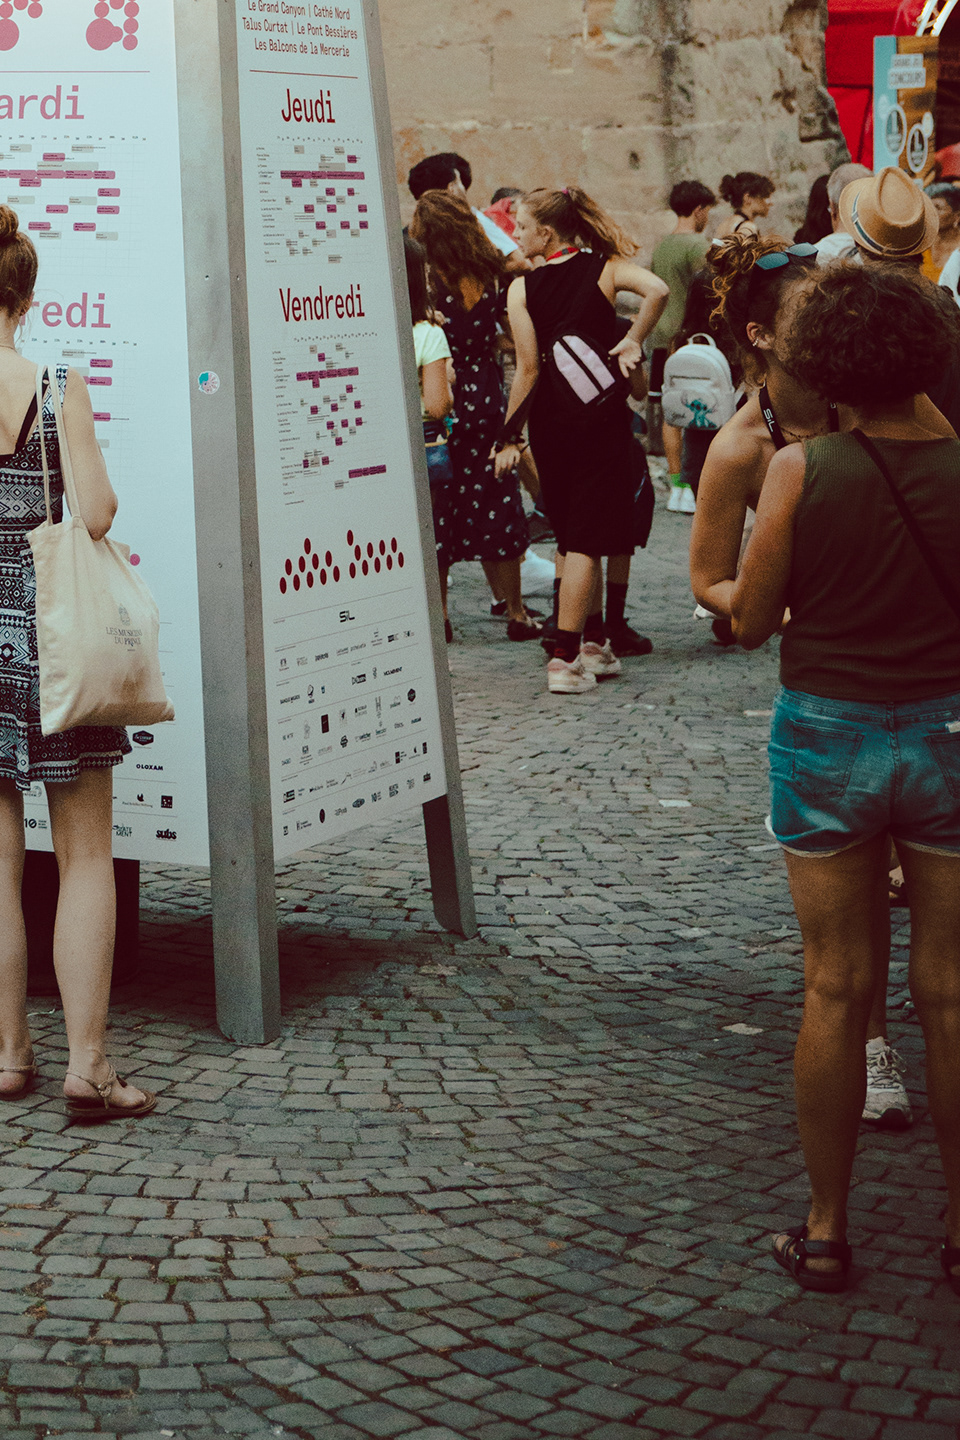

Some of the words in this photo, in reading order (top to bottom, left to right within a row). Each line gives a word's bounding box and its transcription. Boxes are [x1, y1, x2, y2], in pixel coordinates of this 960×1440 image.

[258, 0, 279, 13] Grand
[280, 1, 306, 18] Canyon
[313, 4, 333, 18] Cathé
[334, 7, 351, 20] Nord
[242, 16, 262, 31] Talus
[263, 19, 288, 33] Curtat
[296, 22, 305, 35] Le
[307, 23, 323, 36] Pont
[324, 24, 358, 40] Bessières
[254, 37, 267, 51] Les
[269, 38, 297, 54] Balcons
[299, 42, 308, 54] de
[309, 42, 318, 55] la
[319, 43, 350, 57] Mercerie
[281, 88, 336, 124] Jeudi
[279, 284, 365, 322] Vendredi
[105, 626, 118, 636] LES
[155, 827, 177, 840] subs
